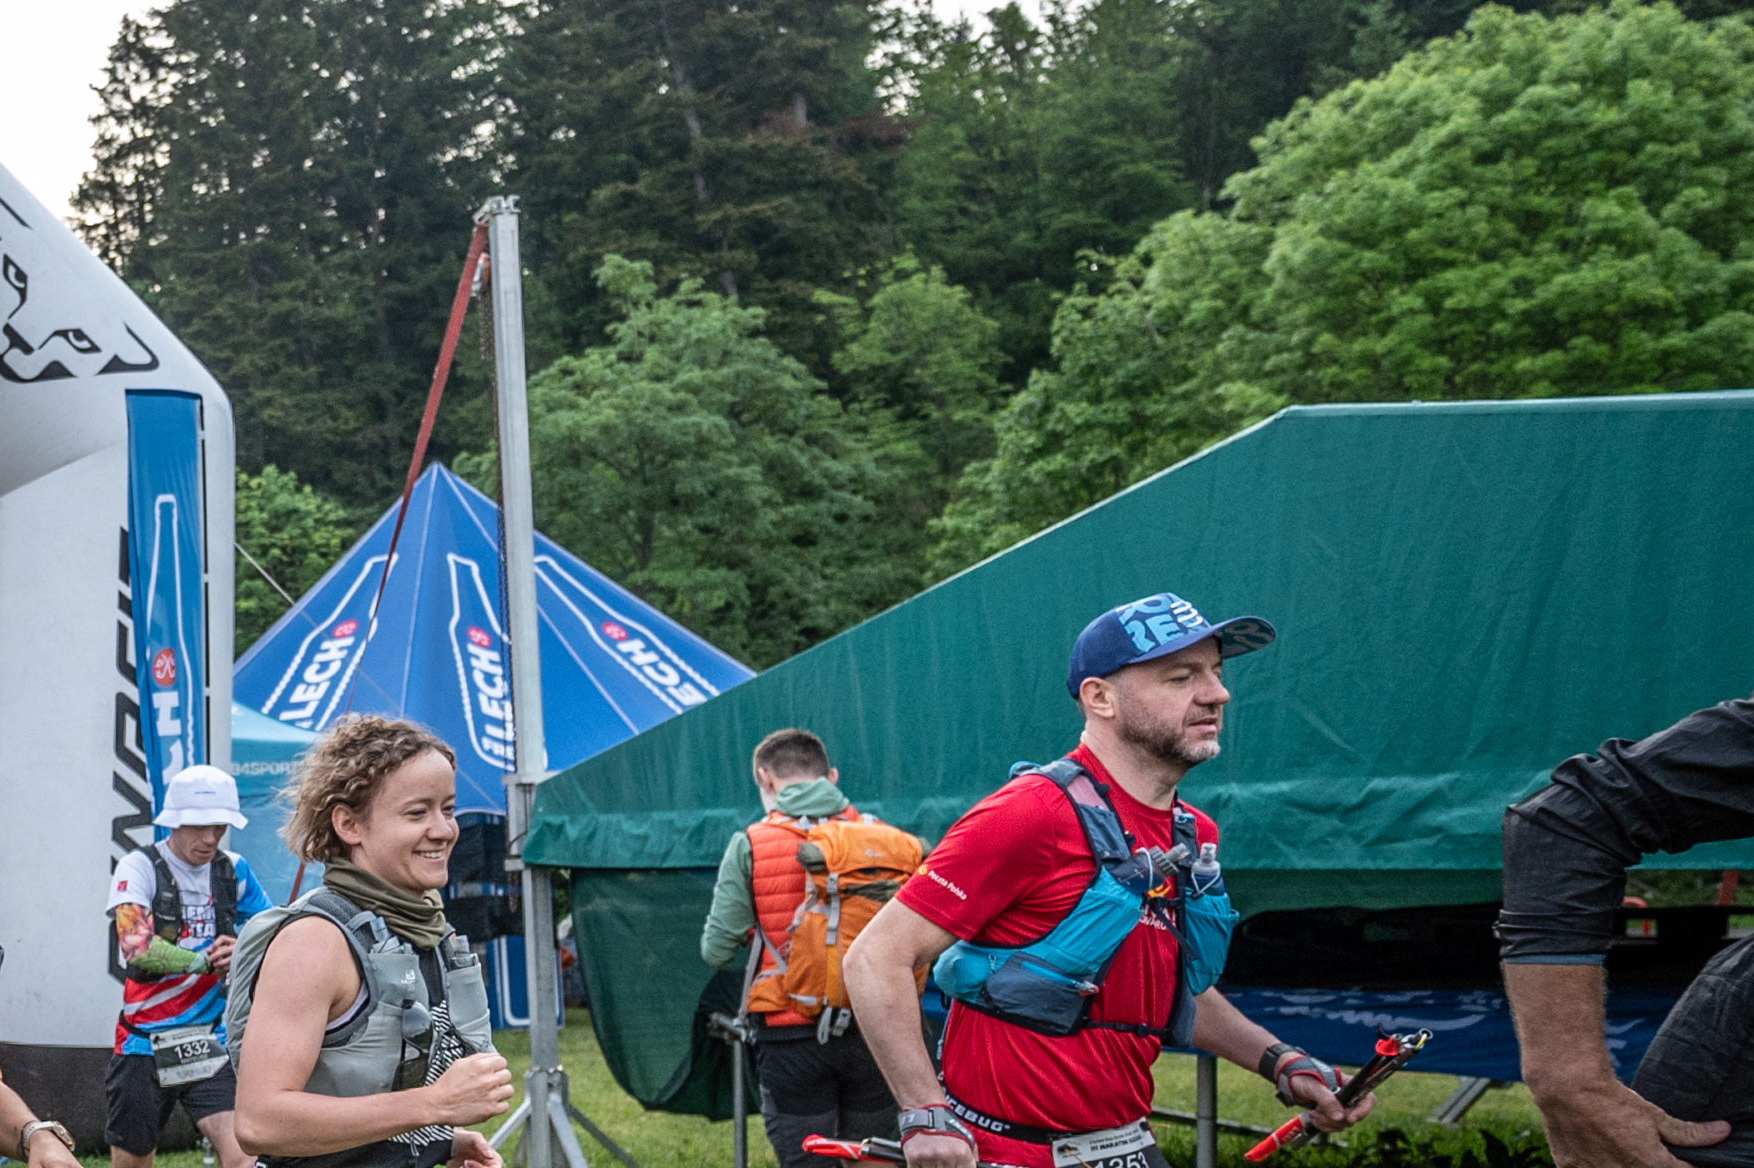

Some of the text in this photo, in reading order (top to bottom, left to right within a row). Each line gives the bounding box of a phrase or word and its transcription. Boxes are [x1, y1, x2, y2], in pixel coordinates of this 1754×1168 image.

[279, 636, 356, 721] LECH
[616, 637, 708, 706] ECH
[174, 1040, 211, 1059] 1332
